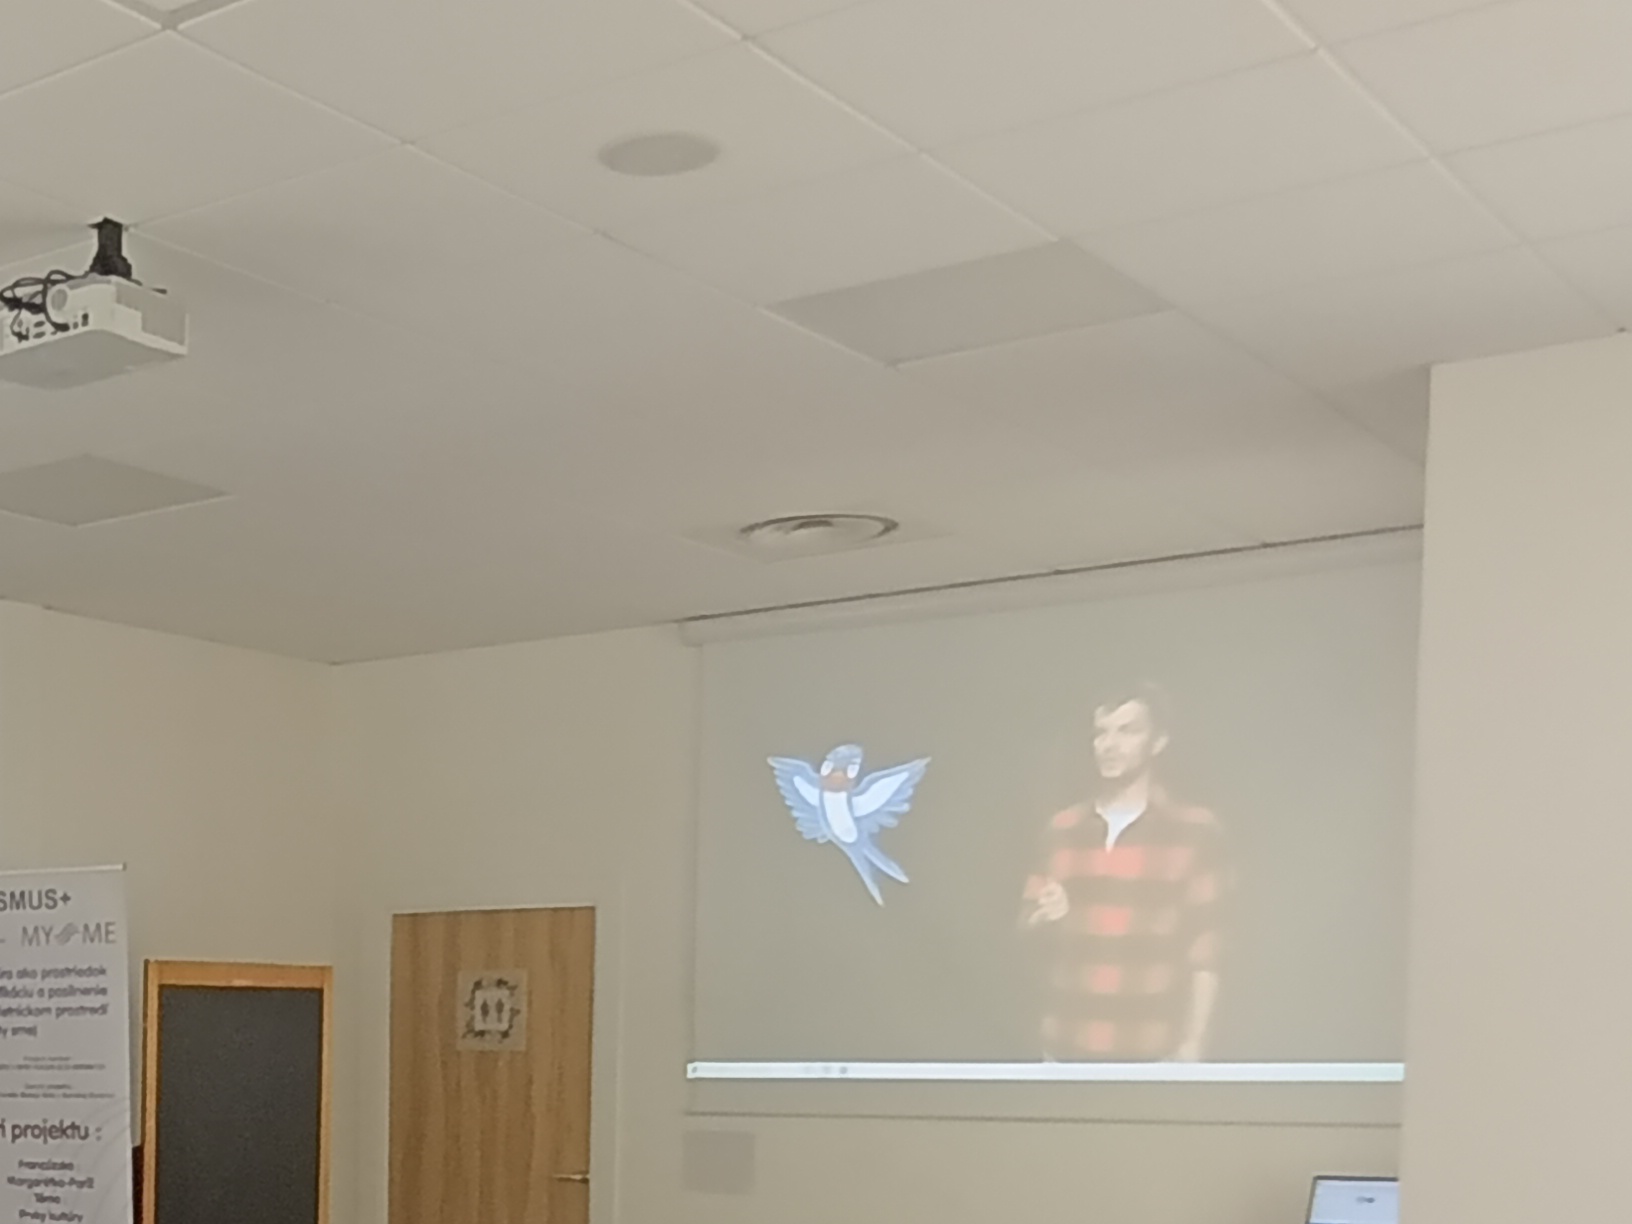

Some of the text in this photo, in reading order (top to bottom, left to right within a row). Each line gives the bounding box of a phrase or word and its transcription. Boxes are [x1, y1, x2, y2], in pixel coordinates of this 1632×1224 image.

[21, 922, 117, 946] MY ME
[11, 1118, 90, 1144] projektu
